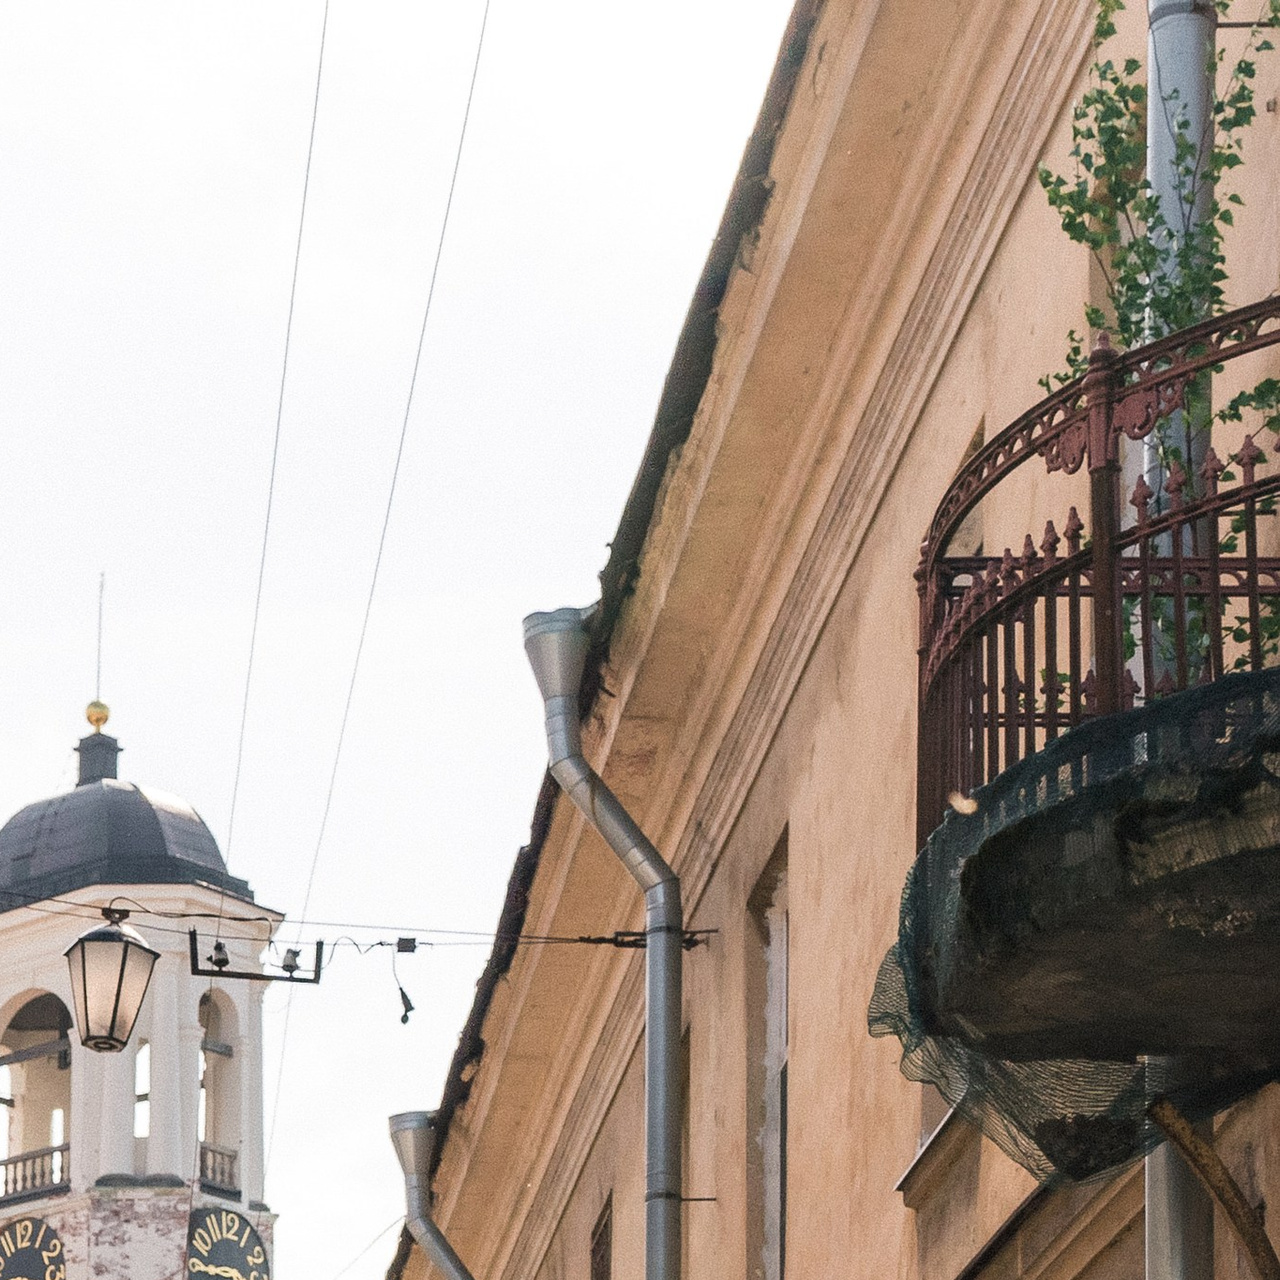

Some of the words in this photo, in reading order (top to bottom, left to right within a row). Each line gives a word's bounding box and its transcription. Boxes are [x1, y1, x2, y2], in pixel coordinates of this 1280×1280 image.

[16, 1220, 32, 1249] 12
[34, 1224, 46, 1248] 1
[206, 1214, 221, 1242] 11
[222, 1211, 239, 1241] 12
[239, 1226, 250, 1248] 1
[0, 1230, 15, 1258] 11
[42, 1238, 61, 1265] 2
[192, 1228, 212, 1257] 10
[246, 1246, 264, 1266] 2
